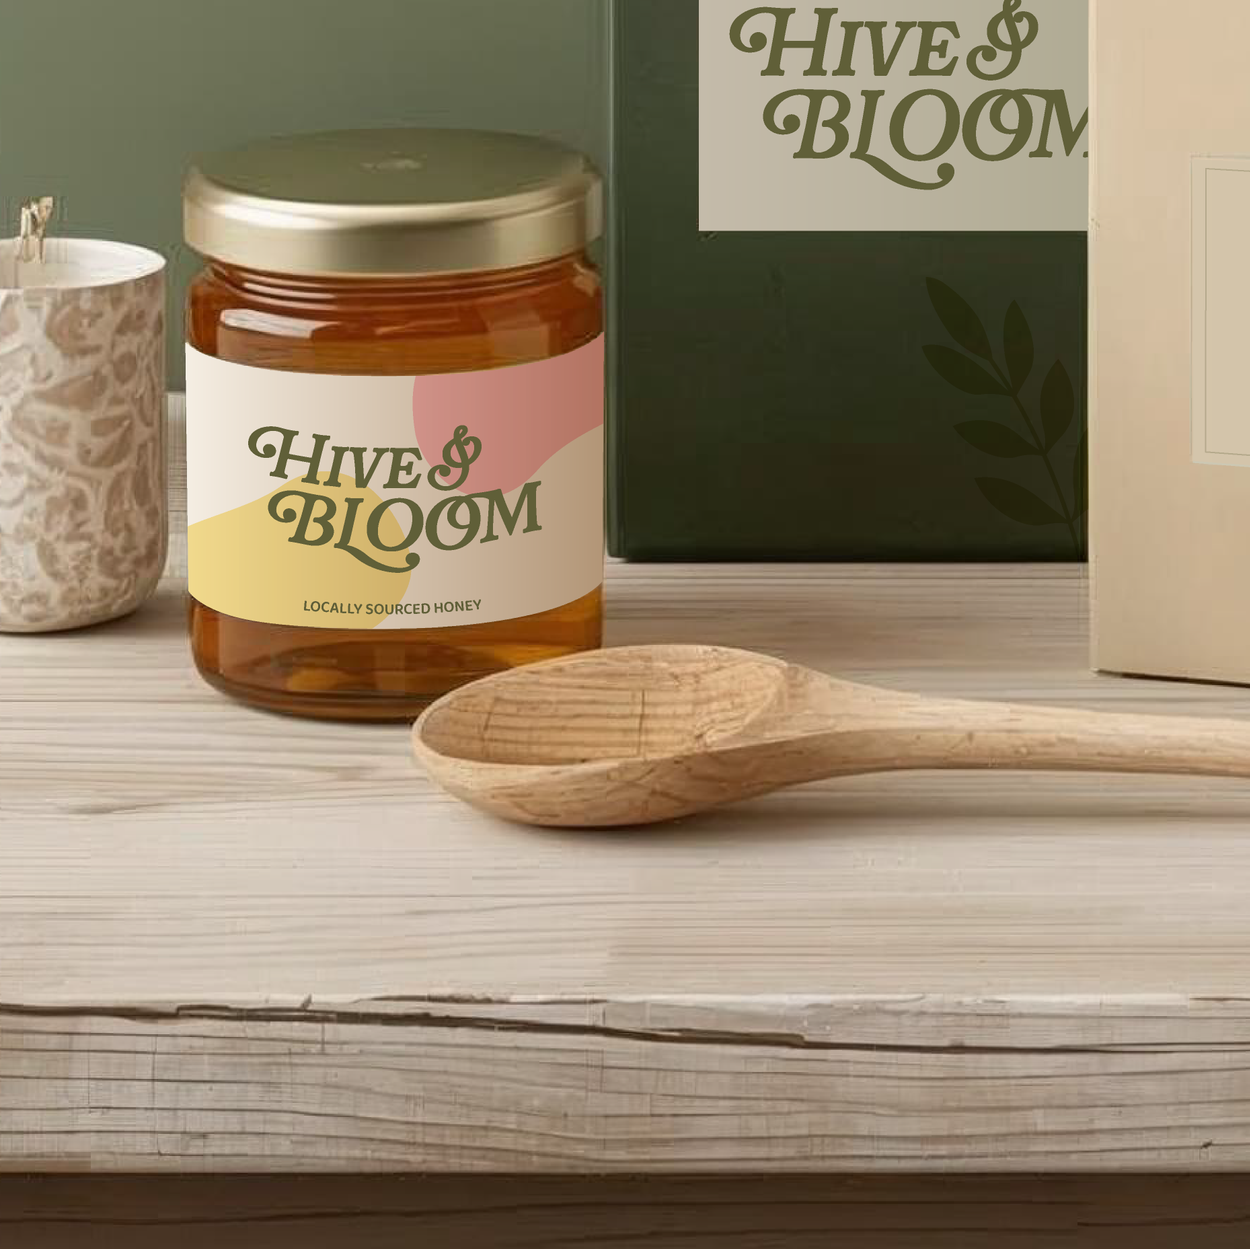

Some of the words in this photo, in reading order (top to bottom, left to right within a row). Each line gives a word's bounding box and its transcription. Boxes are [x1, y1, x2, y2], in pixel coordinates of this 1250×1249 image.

[267, 480, 543, 574] BLOOM
[303, 600, 363, 615] LOCALLY
[365, 603, 431, 615] SOURCED
[433, 598, 482, 614] HONEY
